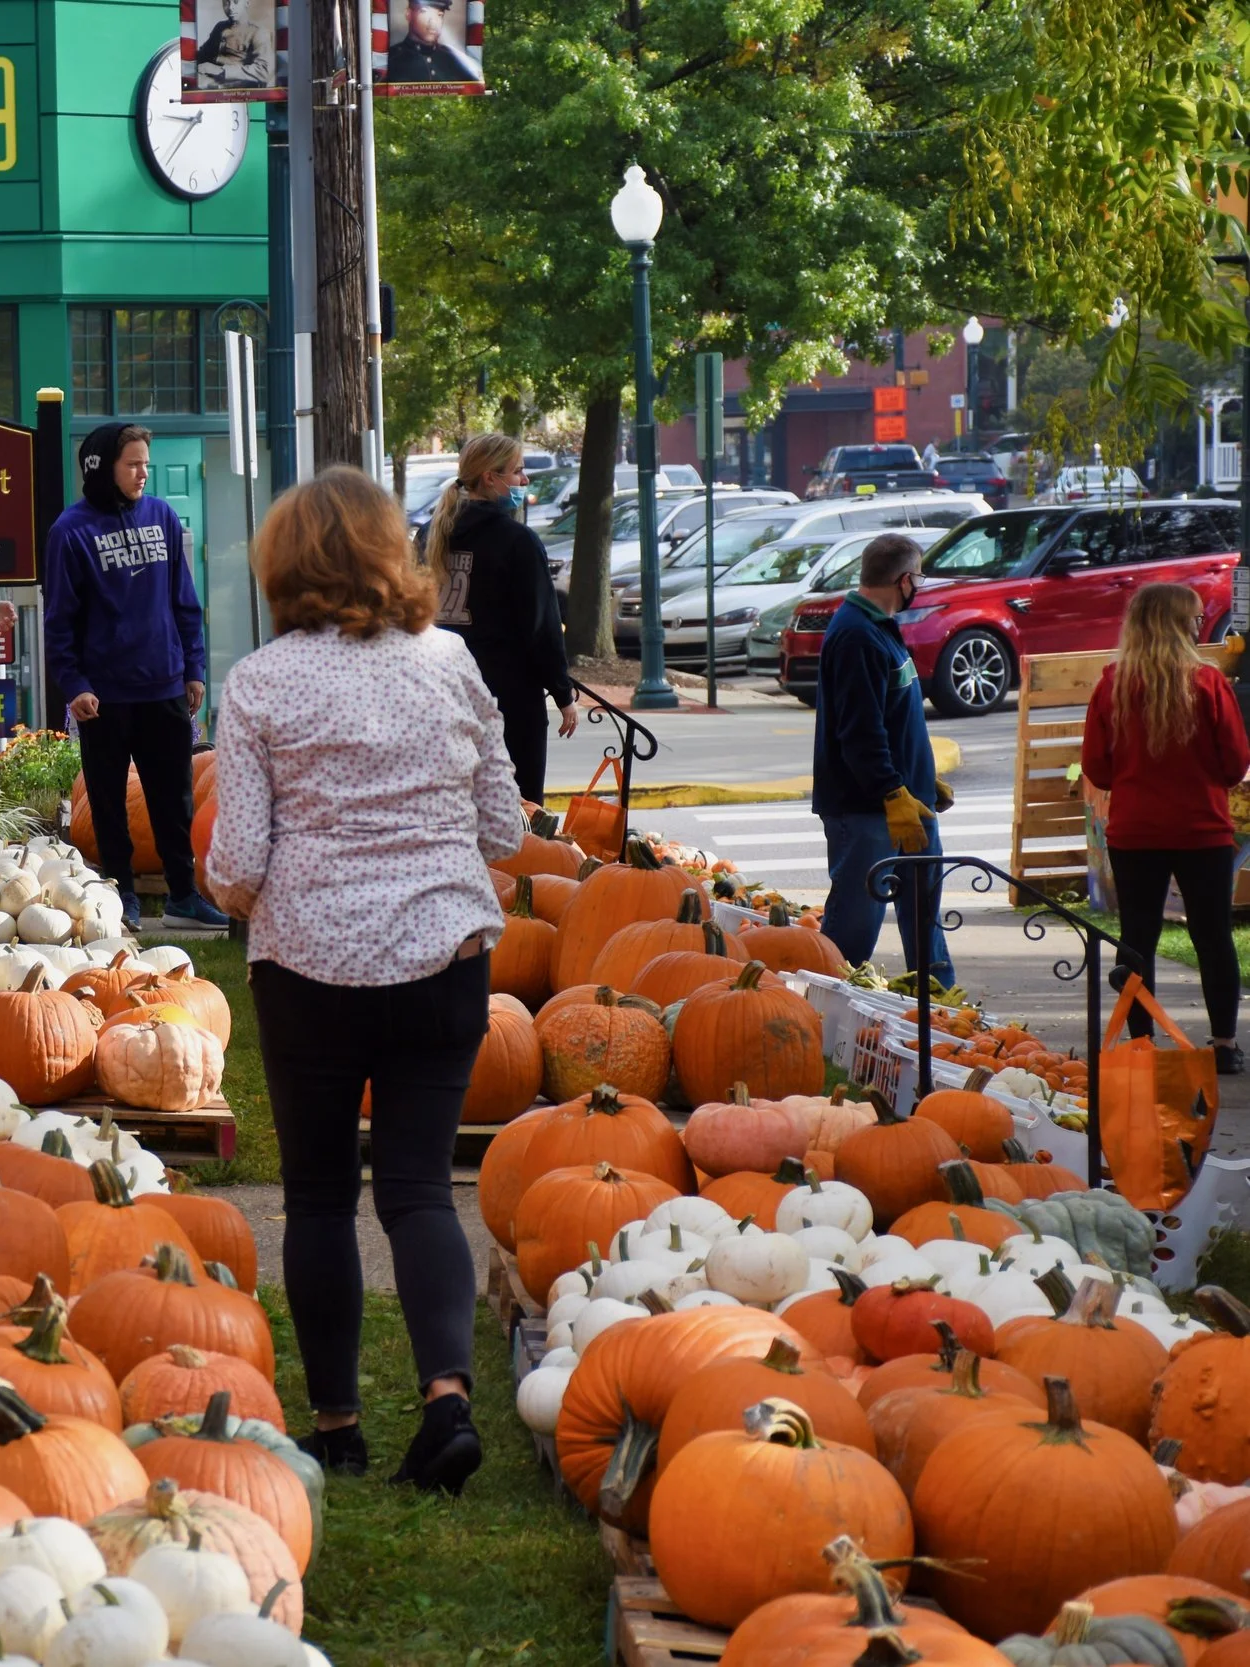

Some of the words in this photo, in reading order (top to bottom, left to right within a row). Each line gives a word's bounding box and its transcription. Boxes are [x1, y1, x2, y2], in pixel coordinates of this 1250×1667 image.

[231, 110, 240, 131] 3
[189, 169, 198, 191] 6
[94, 525, 165, 551] HORNED
[99, 541, 168, 572] FROGS
